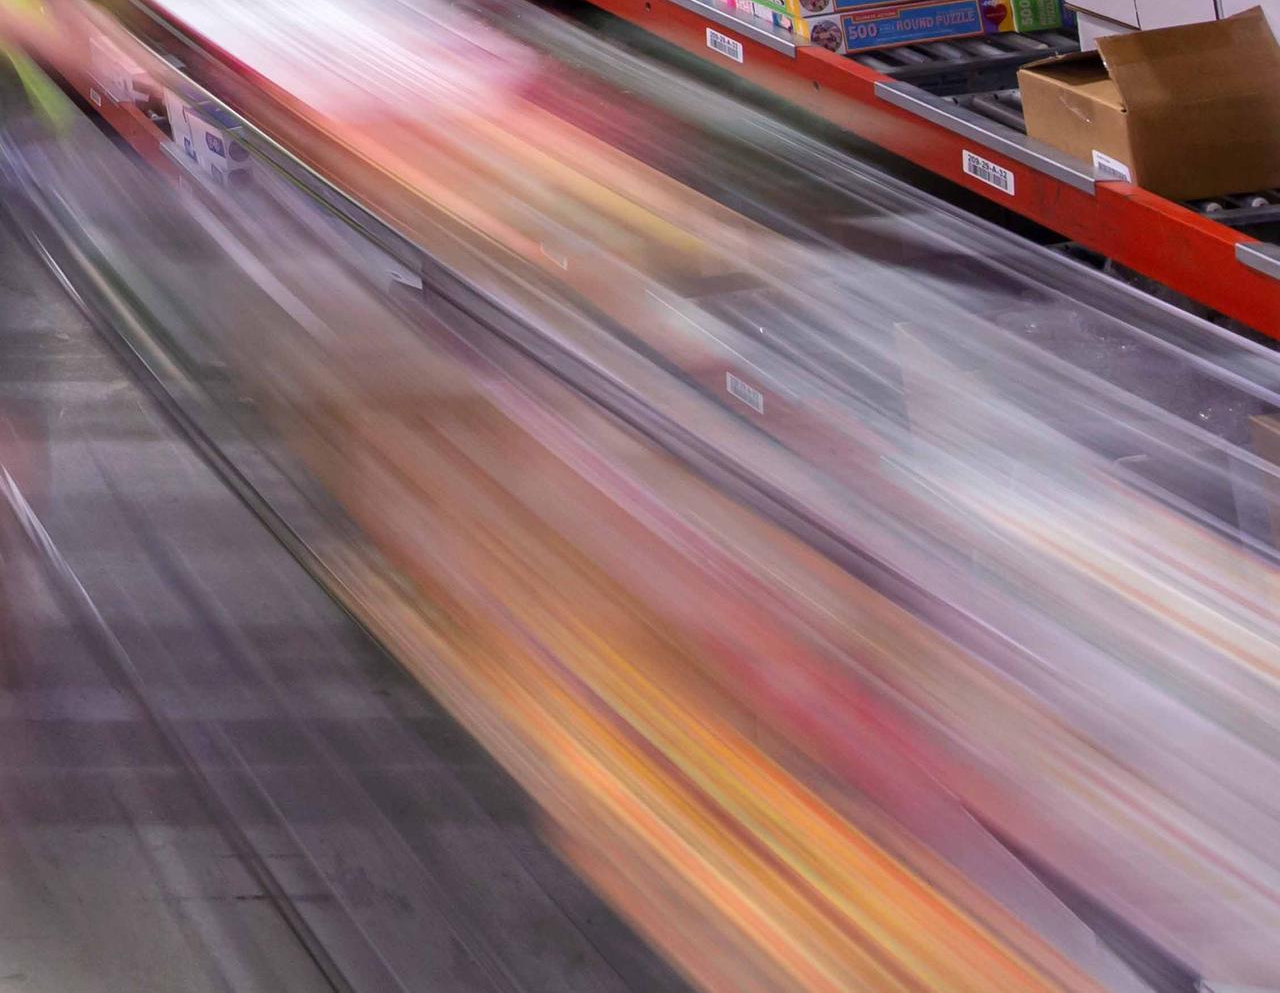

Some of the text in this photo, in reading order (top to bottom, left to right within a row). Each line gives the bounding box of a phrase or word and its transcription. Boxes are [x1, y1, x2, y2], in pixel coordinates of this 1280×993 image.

[847, 9, 976, 40] 500 ROUND PUZZLE
[1019, 0, 1033, 26] 500
